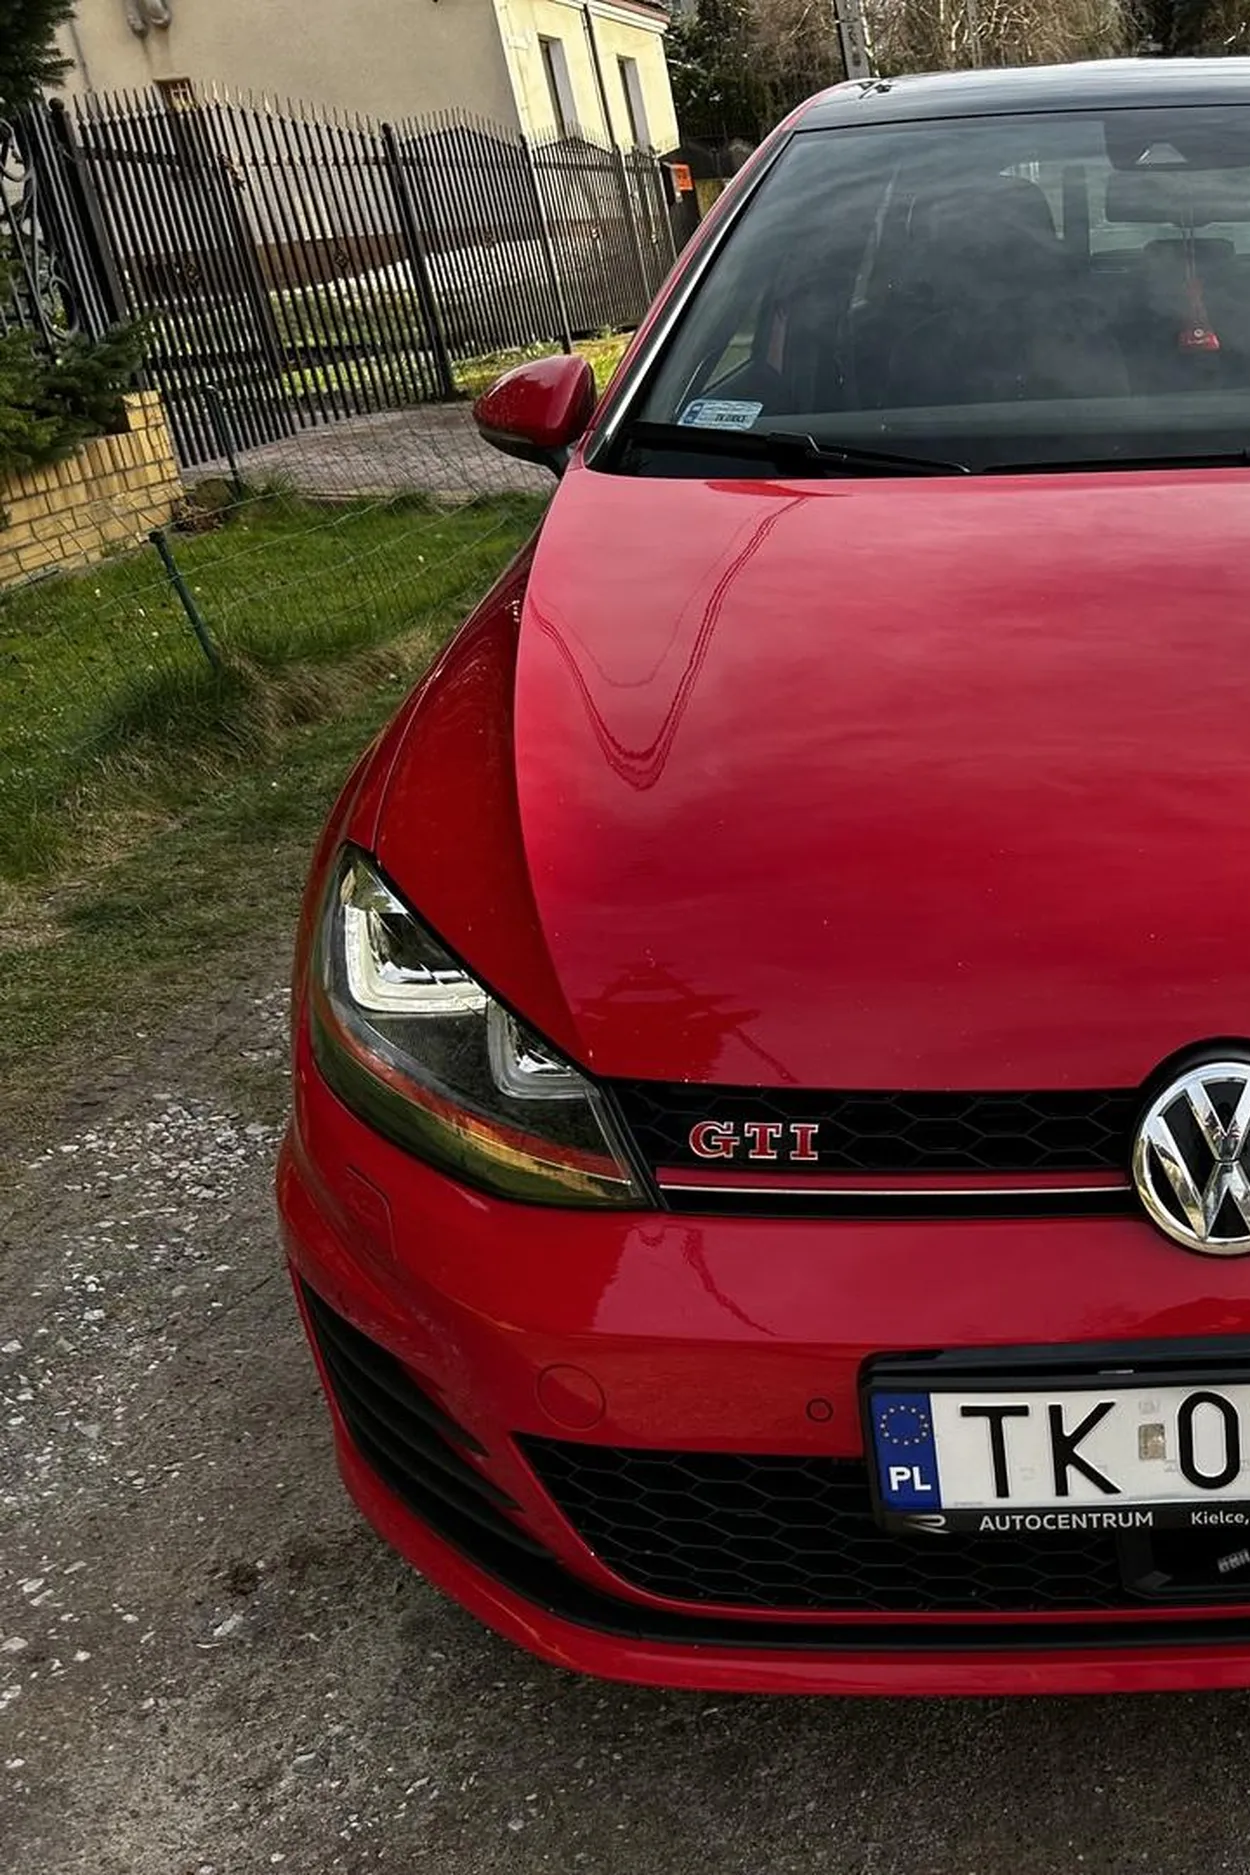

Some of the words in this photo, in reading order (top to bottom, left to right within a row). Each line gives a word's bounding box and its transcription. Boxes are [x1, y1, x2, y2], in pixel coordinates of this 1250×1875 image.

[689, 1121, 819, 1160] GTI
[960, 1401, 1121, 1498] TK
[889, 1466, 932, 1491] PL
[979, 1511, 1153, 1531] AUTOCENTRUM
[1191, 1511, 1249, 1525] Kielce,
